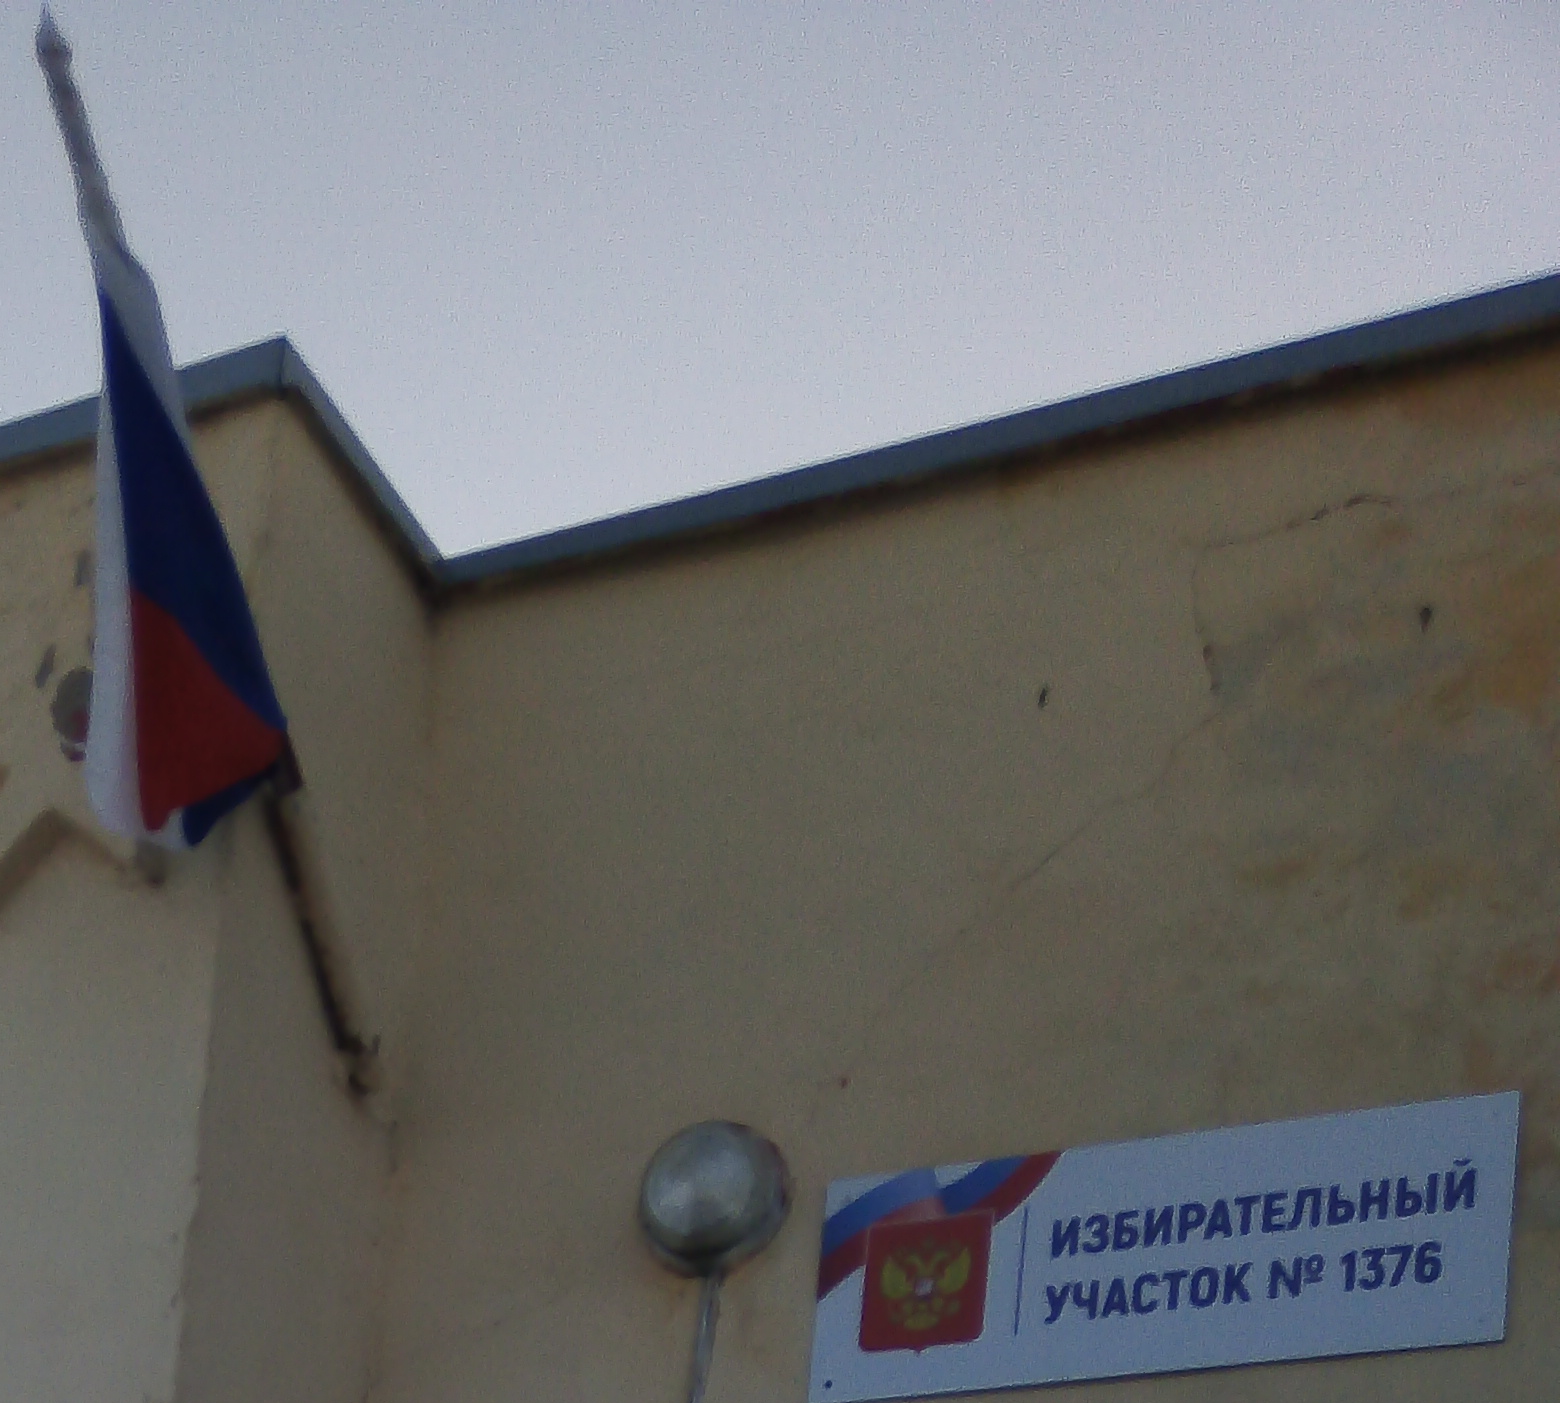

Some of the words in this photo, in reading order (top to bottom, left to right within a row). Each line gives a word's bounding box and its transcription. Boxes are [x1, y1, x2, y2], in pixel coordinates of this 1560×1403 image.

[1048, 1156, 1478, 1260] ИЗБИРАТЕЛЬНЫЙ
[1043, 1263, 1250, 1325] УЧАСТОК
[1340, 1241, 1443, 1292] 1376
